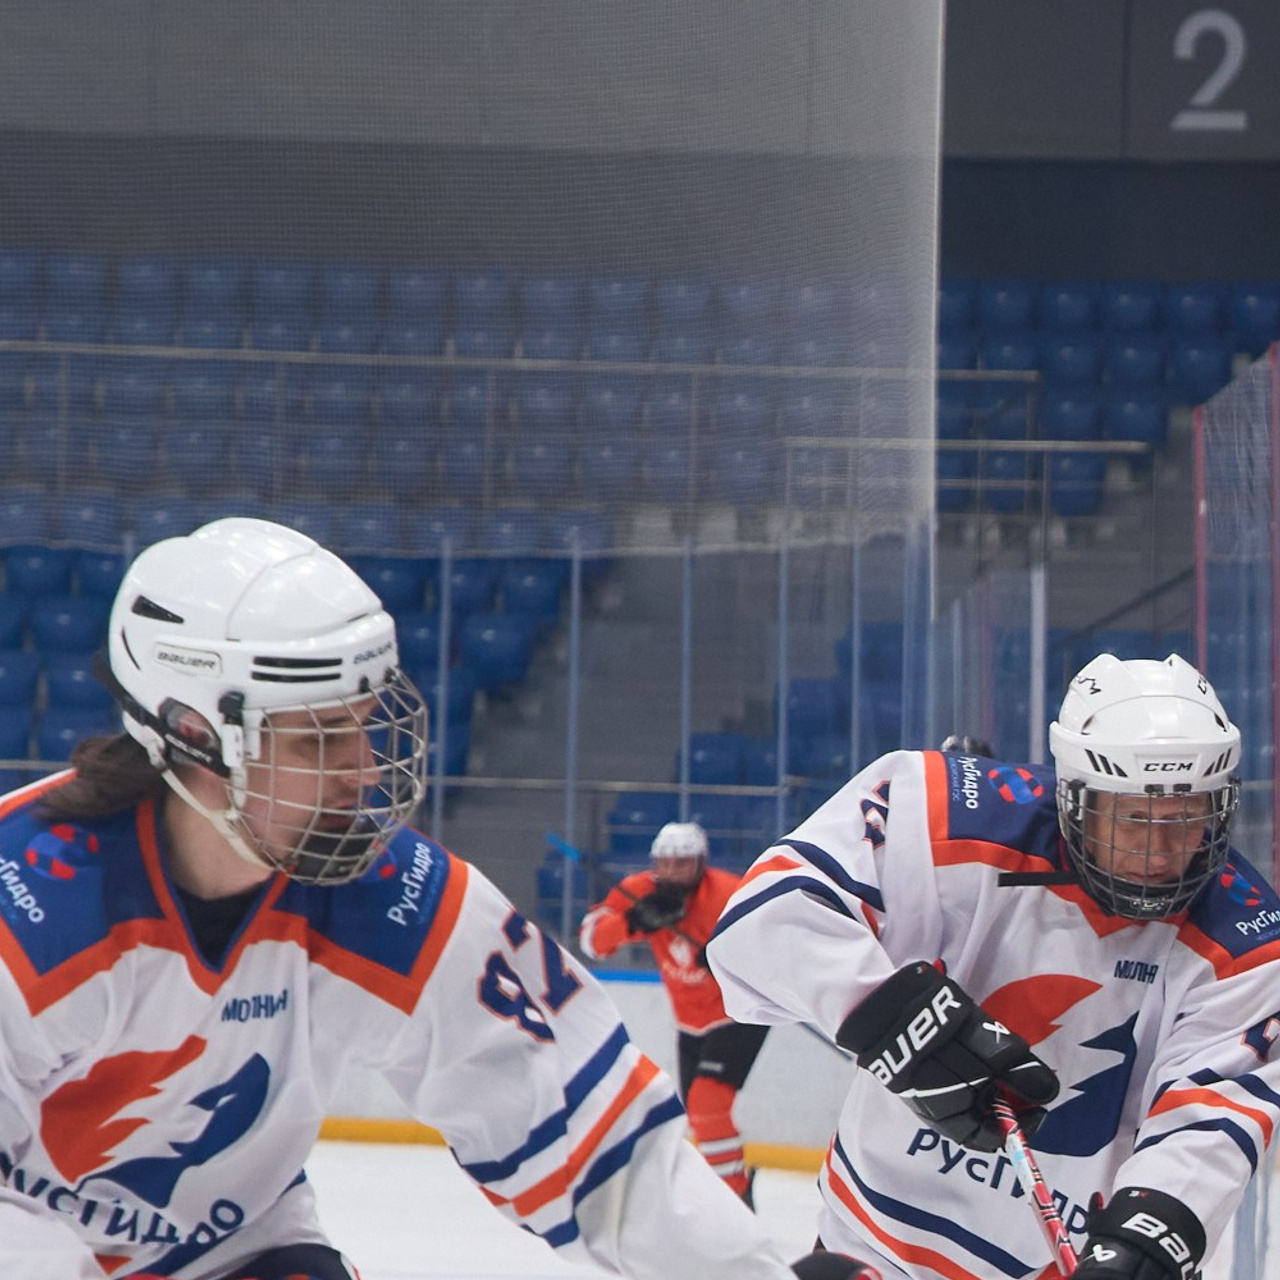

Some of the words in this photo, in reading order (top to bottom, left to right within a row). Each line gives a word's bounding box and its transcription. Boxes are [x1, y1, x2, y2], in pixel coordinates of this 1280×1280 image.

[1172, 9, 1248, 130] 2
[156, 651, 217, 669] BAUER
[956, 756, 980, 810] усГидро
[1142, 762, 1194, 772] CCM
[386, 841, 432, 926] РусГидро
[868, 985, 962, 1086] AUER
